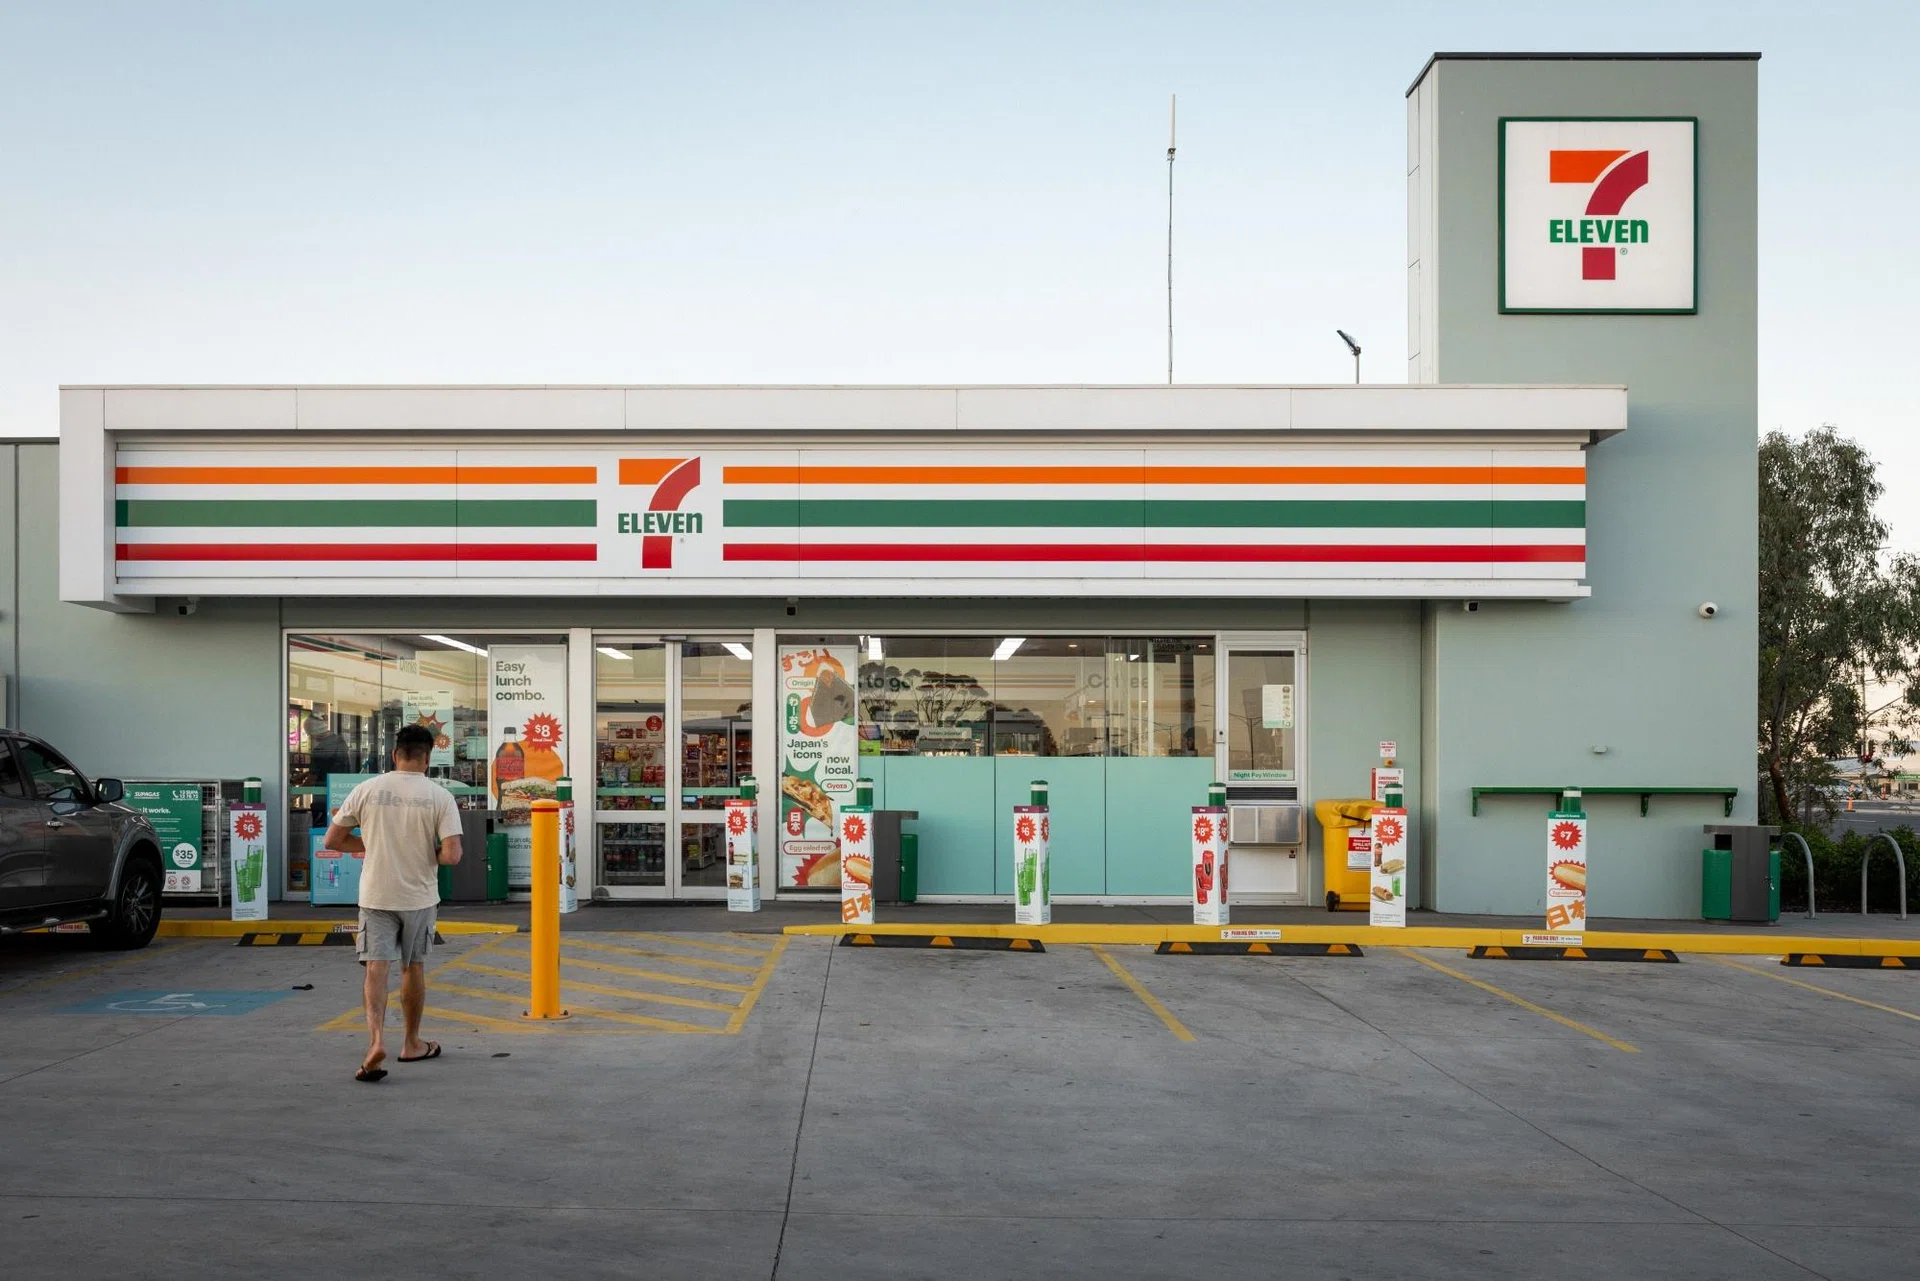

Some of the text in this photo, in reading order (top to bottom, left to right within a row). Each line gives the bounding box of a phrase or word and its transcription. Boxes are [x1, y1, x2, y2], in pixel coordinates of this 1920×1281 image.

[1550, 150, 1649, 280] 7
[618, 456, 701, 569] 7
[495, 661, 526, 675] Easy
[495, 675, 532, 687] lunch
[495, 689, 546, 701] combo.
[534, 724, 551, 737] $8
[787, 739, 829, 750] Japan's
[793, 749, 823, 759] icons
[826, 756, 850, 764] now
[825, 765, 854, 775] local.
[826, 782, 848, 790] Gyoza
[732, 816, 742, 826] $8
[790, 812, 801, 833] 日本
[243, 823, 255, 833] $6
[849, 825, 859, 835] $7
[1021, 826, 1031, 837] $6
[1382, 825, 1395, 835] $6
[1560, 830, 1573, 841] $7
[789, 844, 802, 852] Egg
[803, 843, 820, 851] salad
[175, 849, 194, 860] $35
